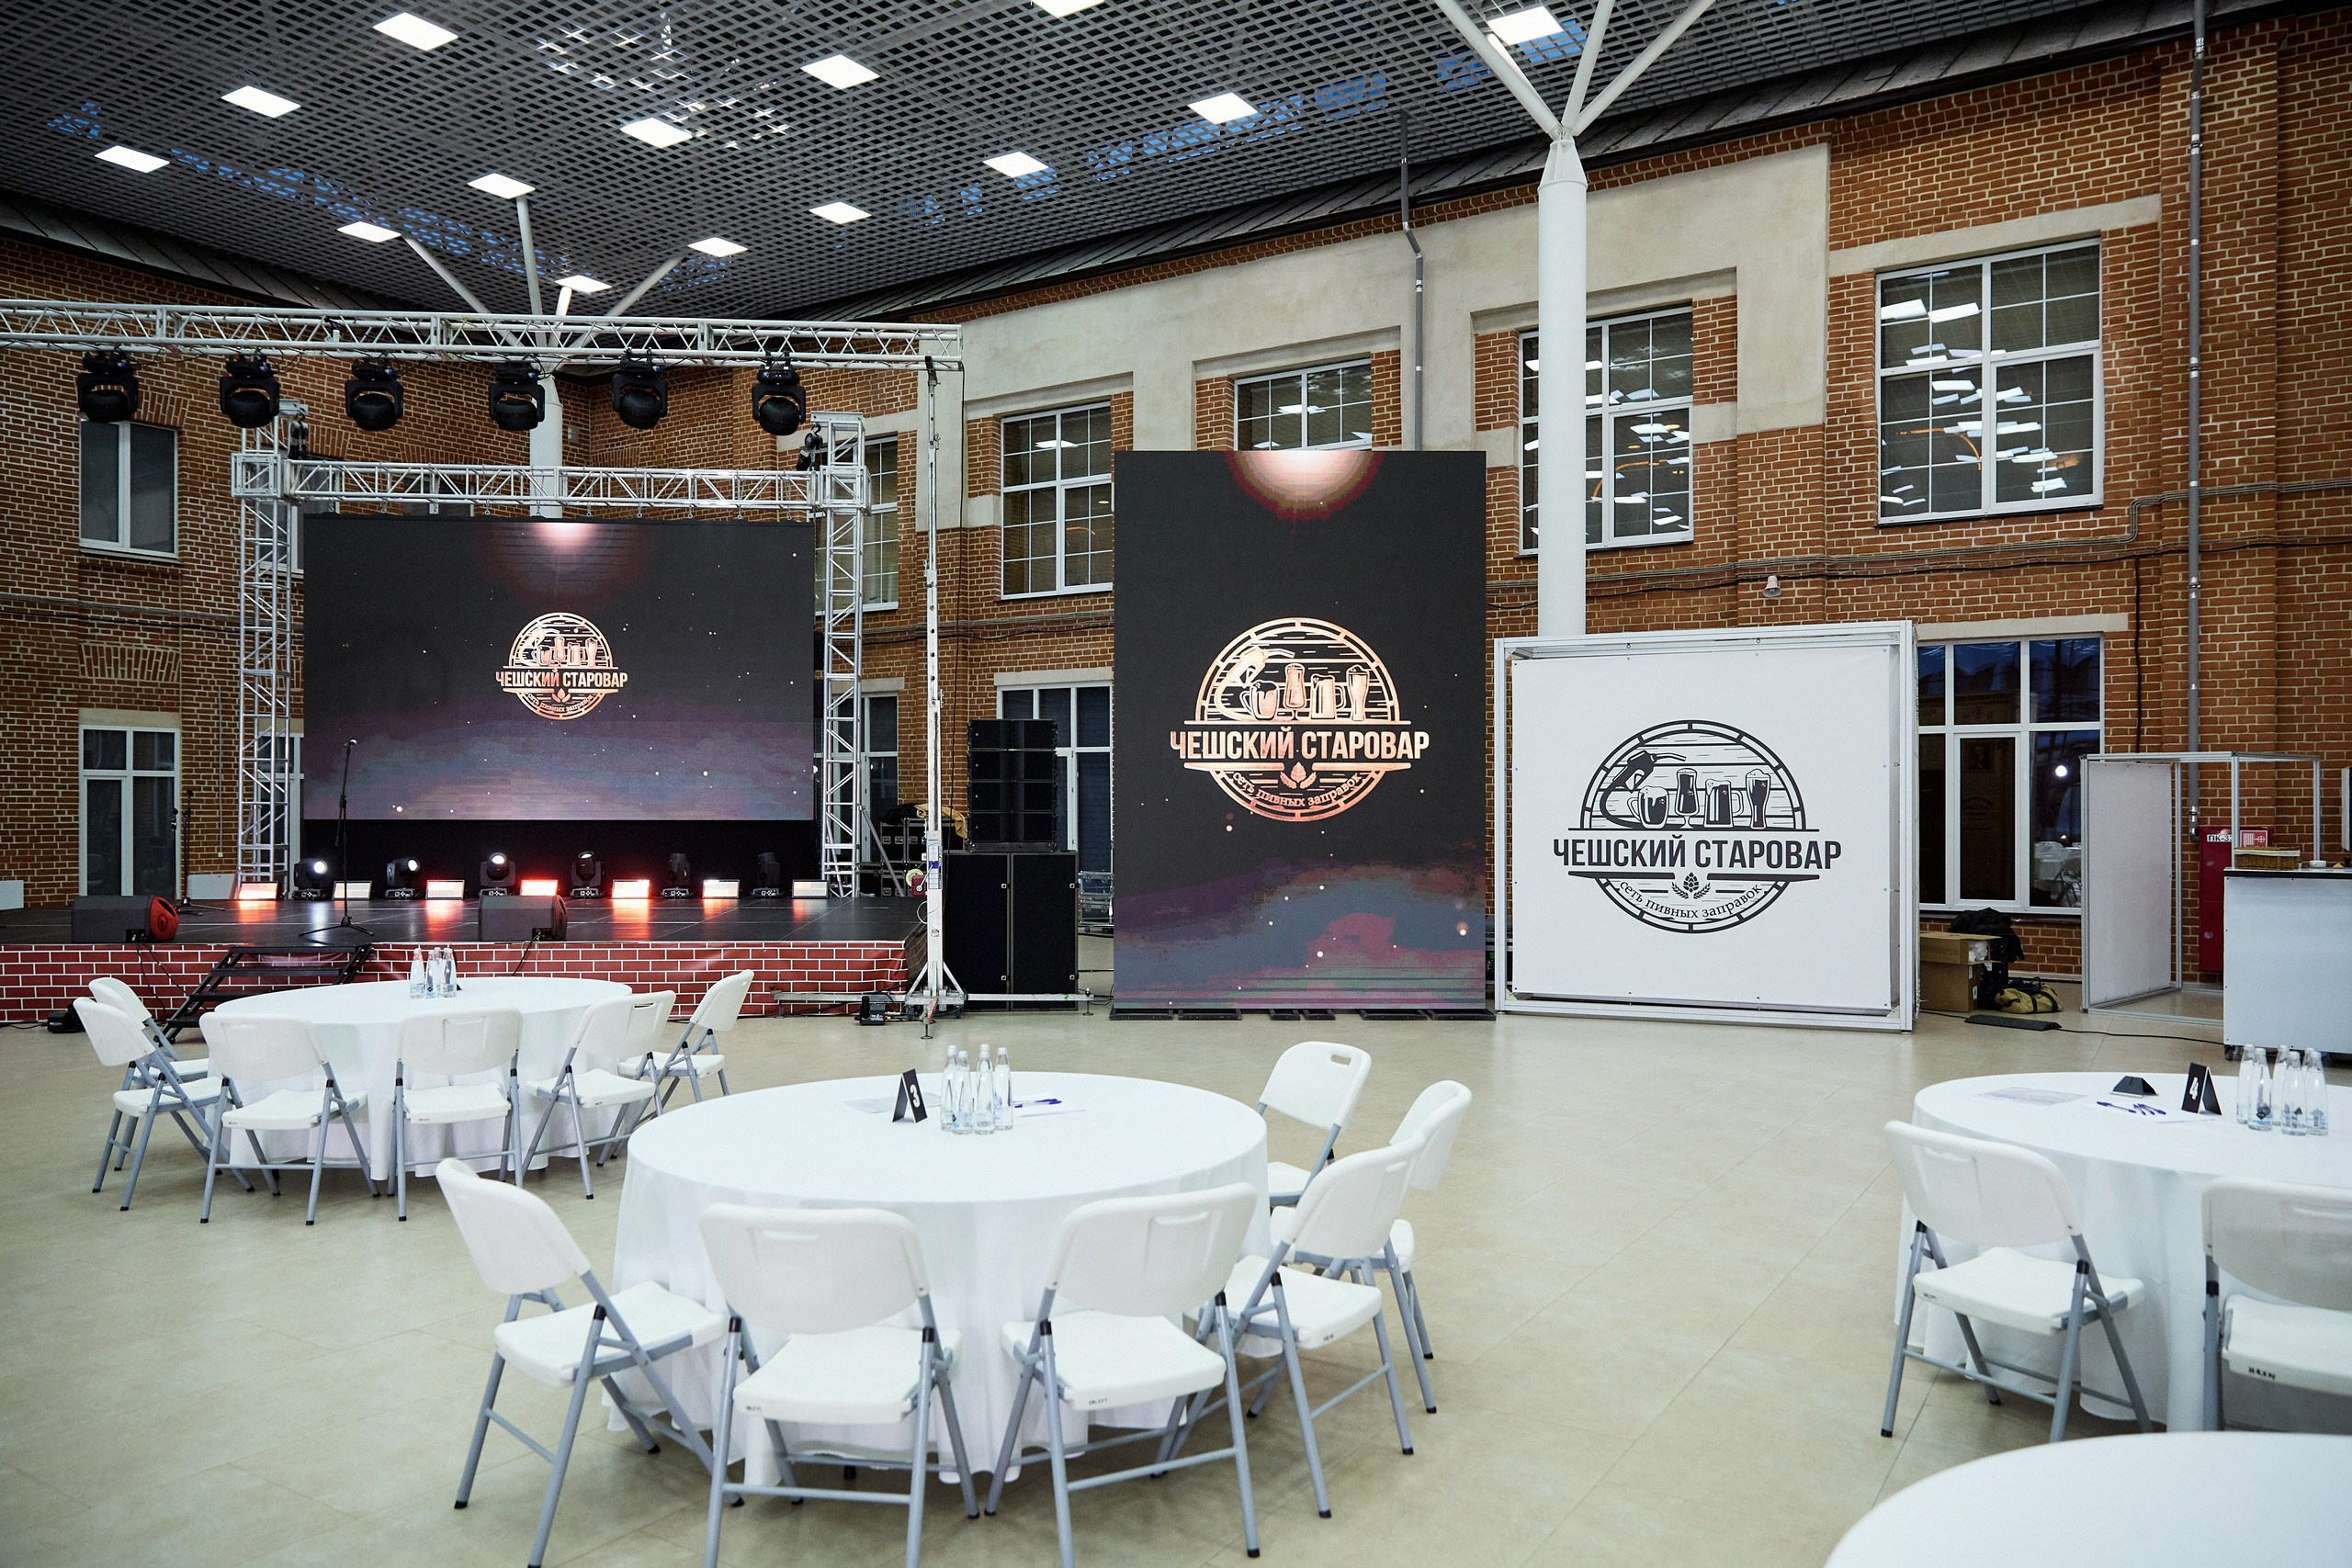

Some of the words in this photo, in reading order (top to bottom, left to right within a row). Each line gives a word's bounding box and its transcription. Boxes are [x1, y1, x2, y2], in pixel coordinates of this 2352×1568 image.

[495, 669, 560, 687] ЧЕШСКИЙ
[563, 671, 628, 688] СТАРОВАР
[1170, 726, 1295, 760] ЧЕШСКИЙ
[1302, 730, 1430, 760] СТАРОВАР
[1231, 771, 1255, 795] сеть
[1255, 788, 1306, 807] пивных
[1307, 773, 1364, 807] заправок
[1554, 834, 1686, 868] ЧЕШСКИЙ
[1694, 840, 1842, 870] СТАРОВАР
[1620, 880, 1644, 904] сеть
[1645, 898, 1699, 919] пивных
[1702, 884, 1763, 918] заправок
[910, 1084, 921, 1108] 3
[2188, 1077, 2199, 1100] 4
